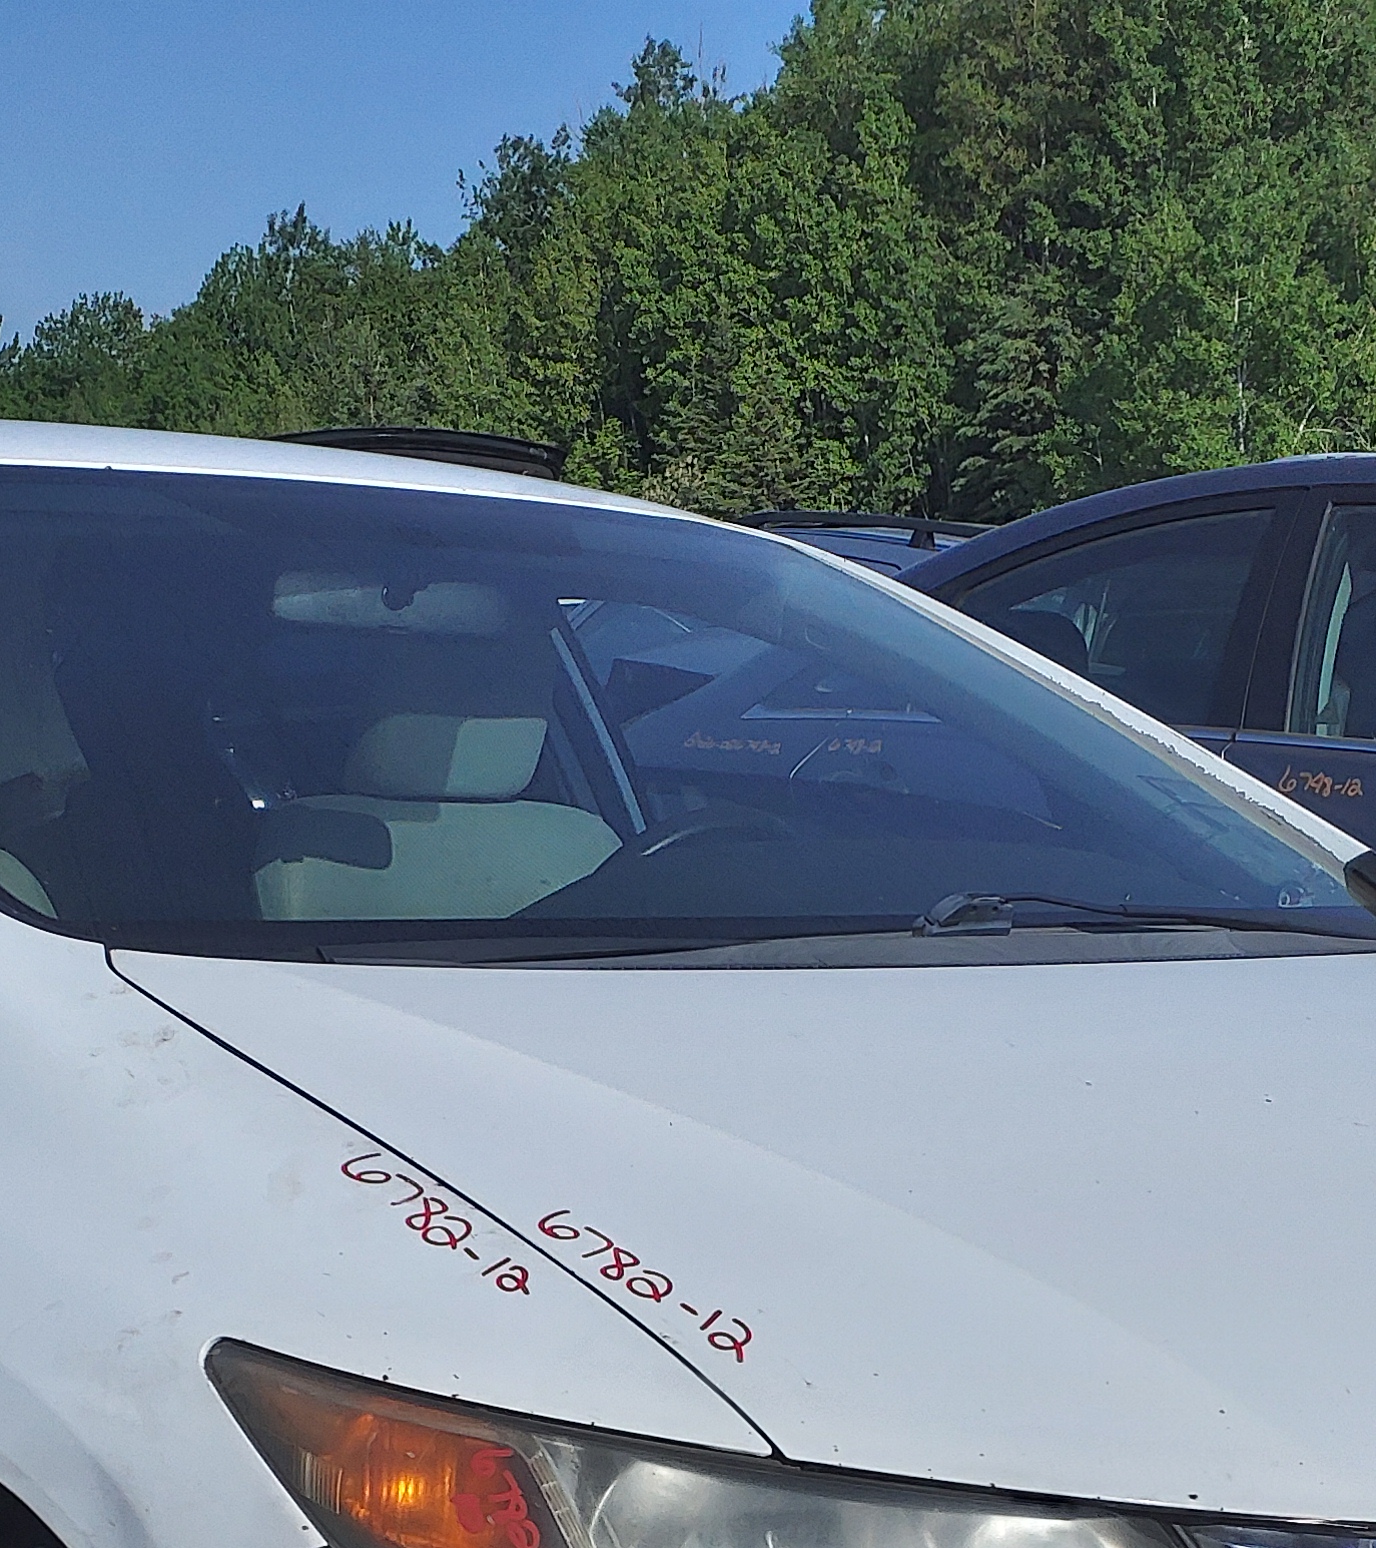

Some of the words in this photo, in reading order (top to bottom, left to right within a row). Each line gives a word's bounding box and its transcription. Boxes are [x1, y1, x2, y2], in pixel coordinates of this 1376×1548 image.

[1278, 764, 1364, 798] 6748-12
[340, 1152, 531, 1296] 6782-12
[537, 1209, 753, 1363] 6782-12
